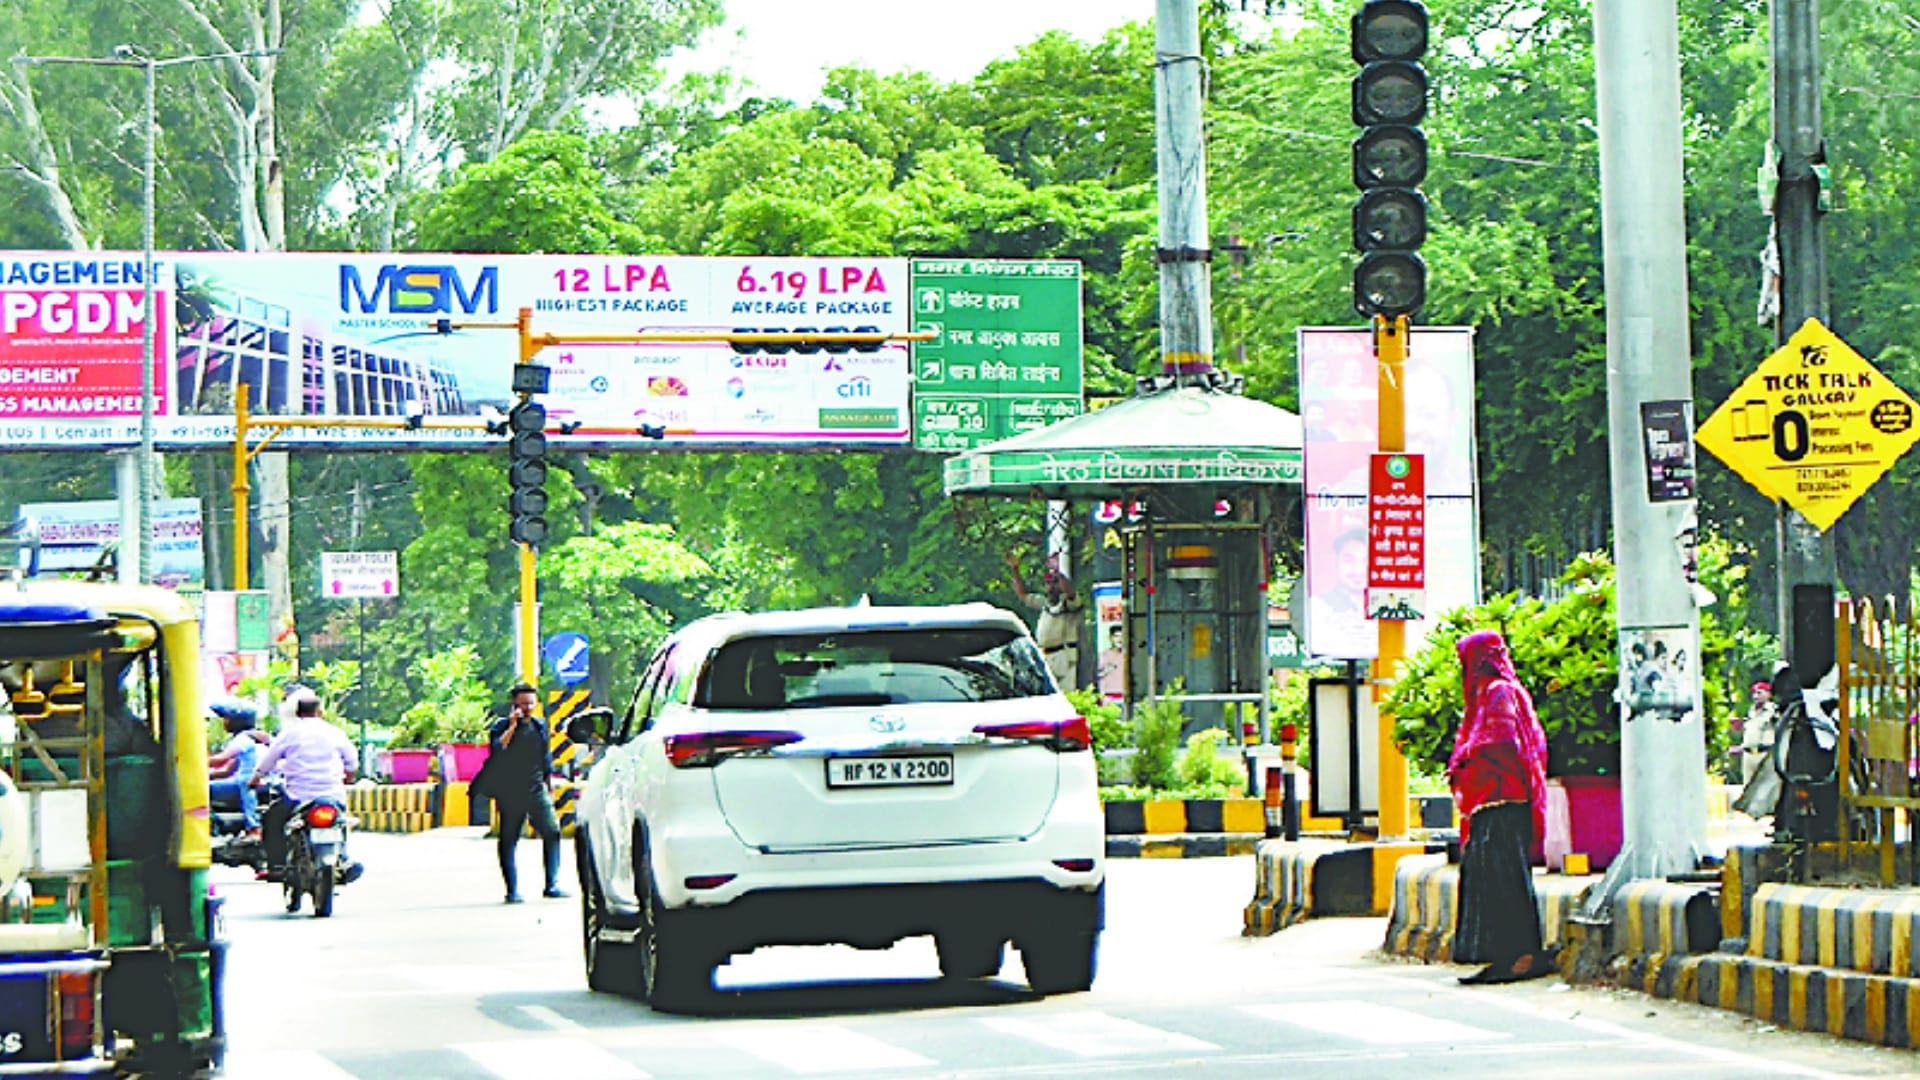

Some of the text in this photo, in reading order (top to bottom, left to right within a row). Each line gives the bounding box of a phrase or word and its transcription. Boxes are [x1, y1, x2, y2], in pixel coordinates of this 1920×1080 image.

[0, 261, 164, 284] AGEMENT
[554, 264, 671, 292] 12 LPA
[737, 265, 887, 299] 6.19 LPA
[340, 265, 498, 314] MSM
[4, 292, 157, 333] PGDM
[535, 299, 688, 312] HIGHEST PACKAGE
[731, 301, 893, 314] AVERAGE PACKAGE
[1762, 371, 1872, 392] TICK TALK
[1782, 390, 1856, 407] GALLERY
[1773, 410, 1809, 461] 0
[1040, 452, 1091, 481] मेरठ
[843, 763, 863, 781] HP
[867, 762, 887, 780] 12
[906, 760, 949, 779] 2200
